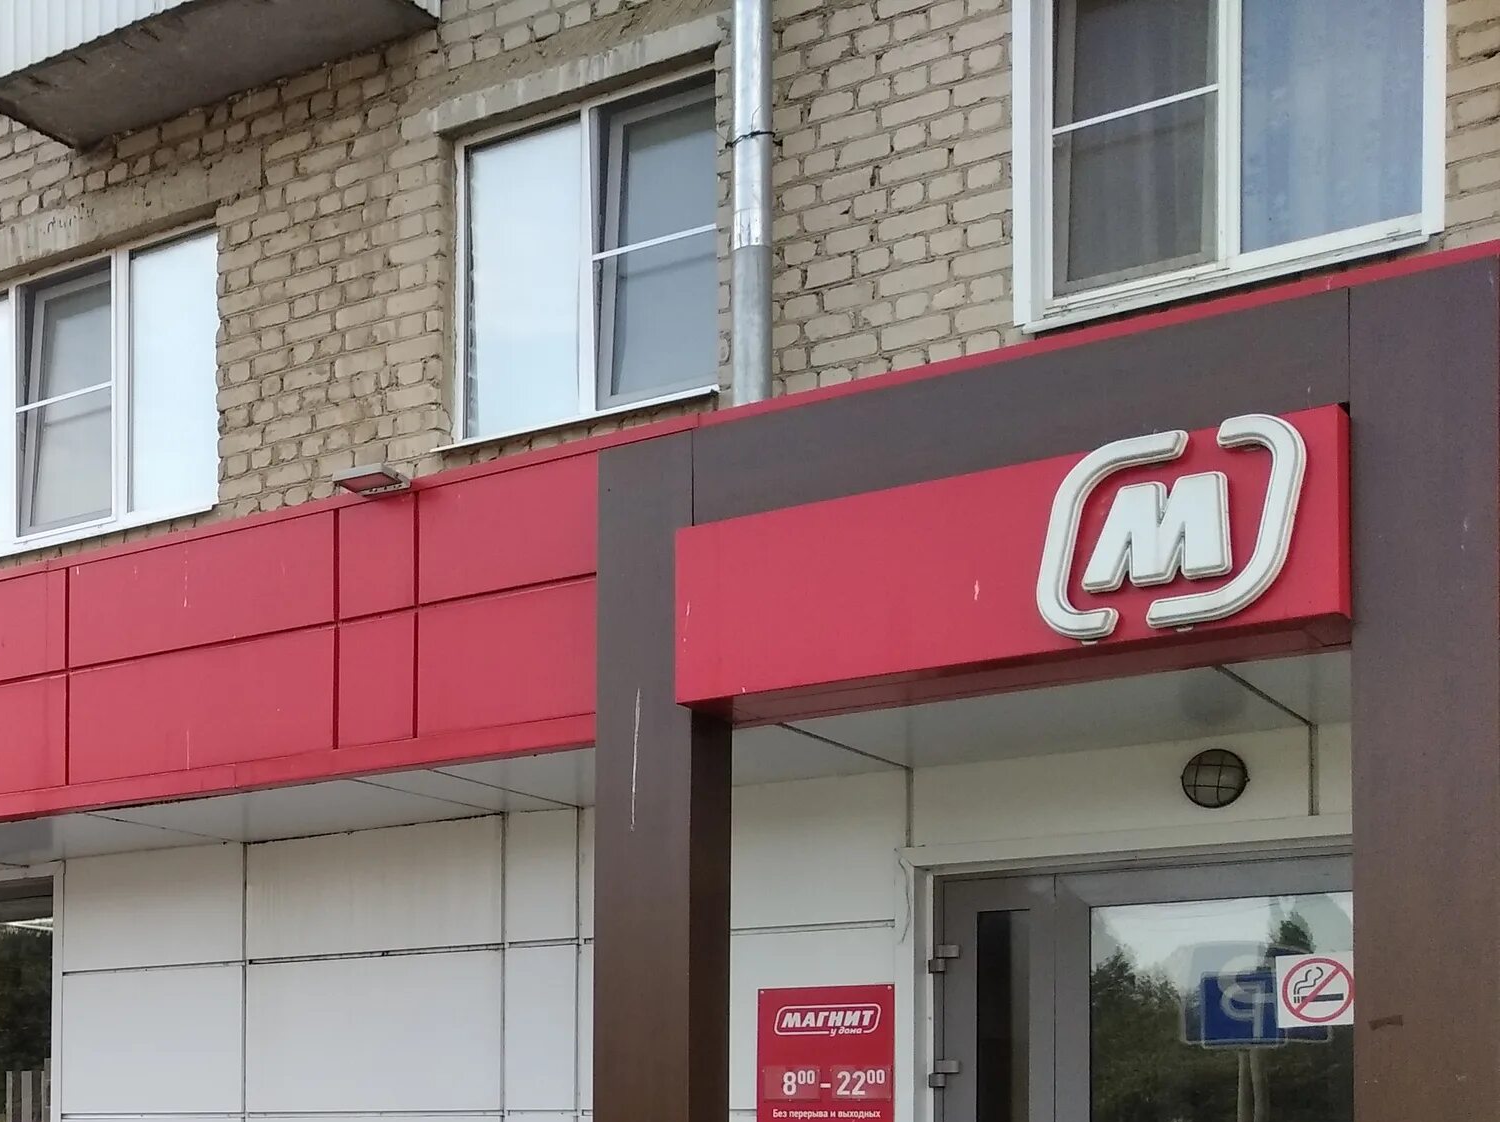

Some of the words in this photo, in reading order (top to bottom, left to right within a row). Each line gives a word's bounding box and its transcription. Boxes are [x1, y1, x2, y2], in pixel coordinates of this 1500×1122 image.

[781, 1010, 874, 1028] МАГНИТ
[829, 1028, 837, 1037] у
[772, 1109, 787, 1118] Без
[789, 1111, 828, 1119] перерыва
[838, 1111, 881, 1119] выходных
